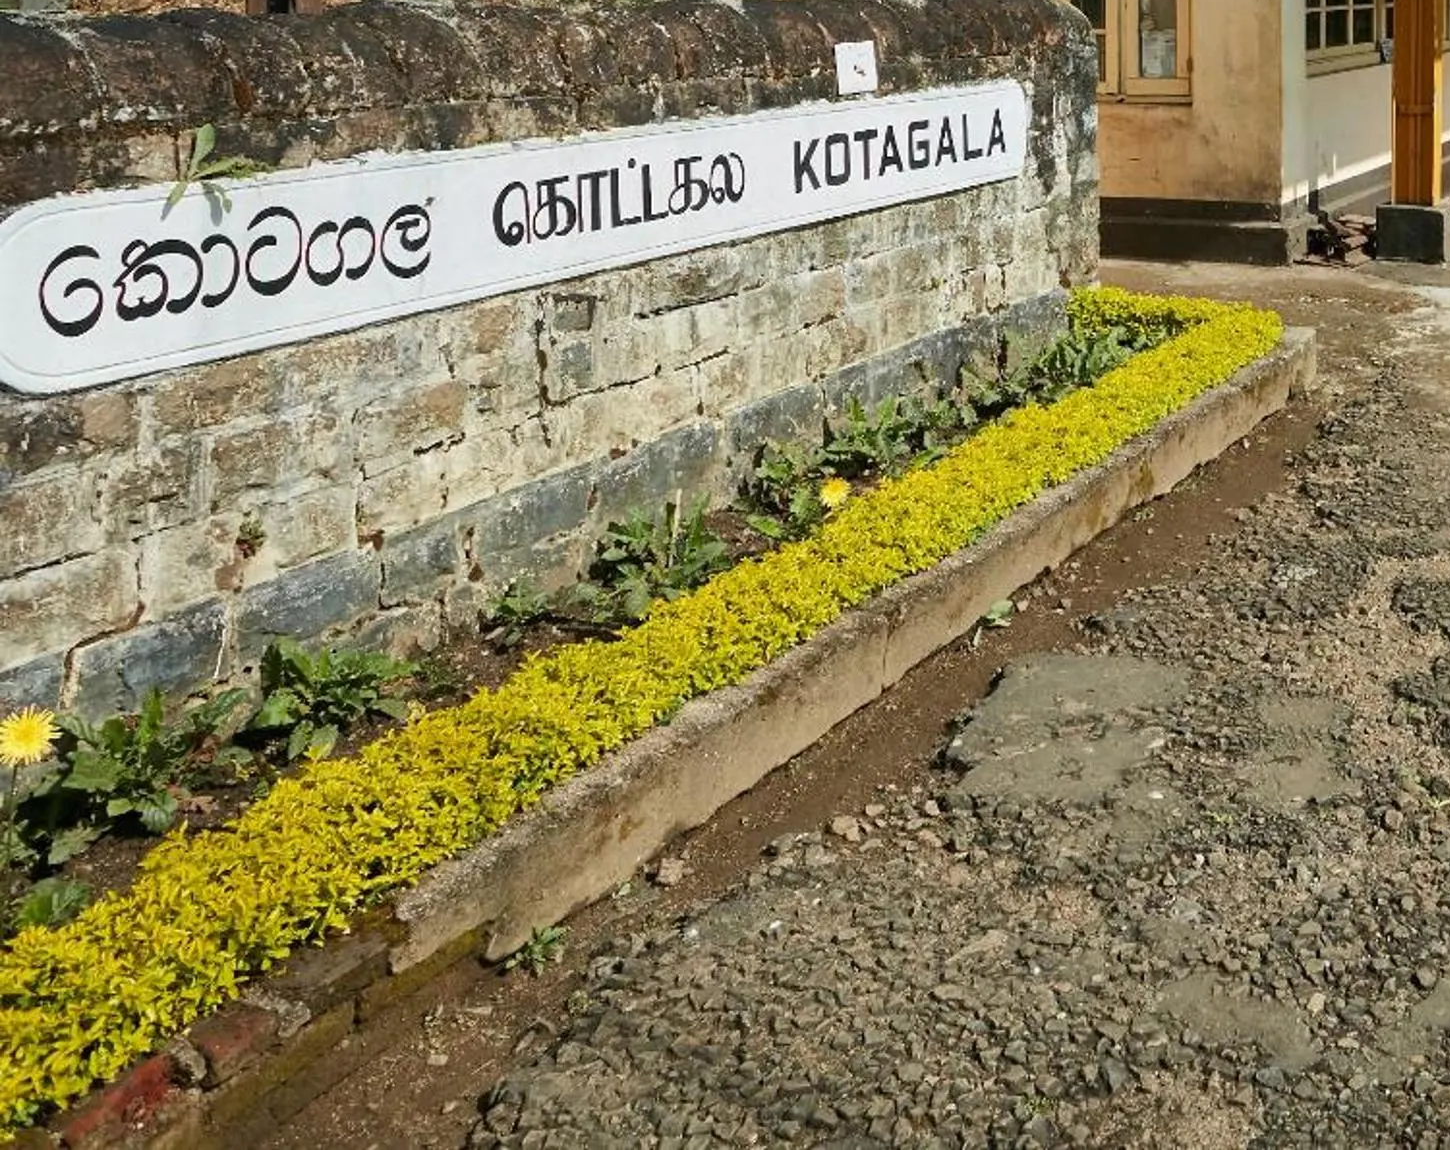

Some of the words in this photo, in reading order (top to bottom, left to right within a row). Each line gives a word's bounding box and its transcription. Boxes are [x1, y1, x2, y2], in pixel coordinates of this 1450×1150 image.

[793, 108, 1007, 194] KOTAGALA
[492, 153, 745, 246] கொட்டகல
[39, 204, 431, 337] කොටගල
